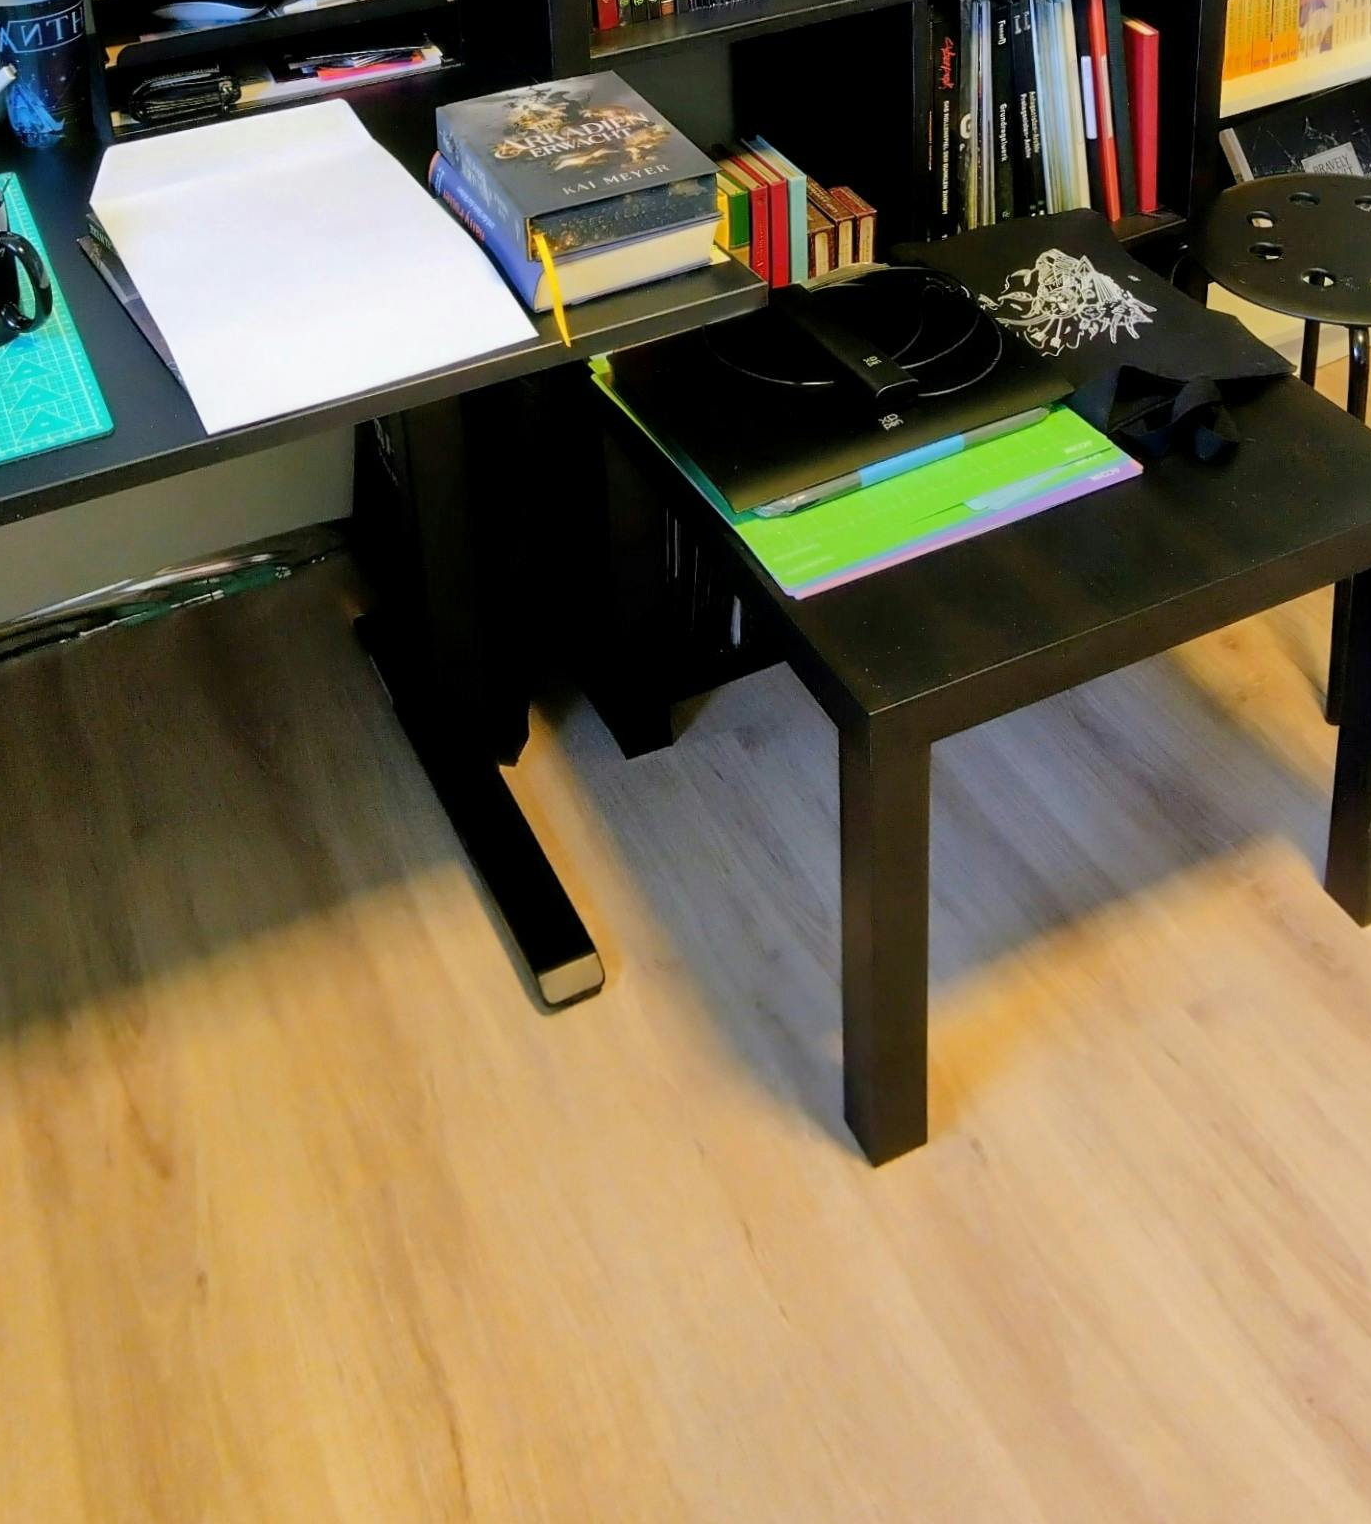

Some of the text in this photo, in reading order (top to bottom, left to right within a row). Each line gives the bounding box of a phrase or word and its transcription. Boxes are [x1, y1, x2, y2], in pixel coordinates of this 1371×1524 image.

[495, 112, 653, 159] ARKADIEN
[530, 128, 633, 158] ERWACHT
[999, 104, 1008, 162] Grundregelwerk
[562, 163, 670, 196] KAI MEYER
[1313, 155, 1349, 174] BRAVELY
